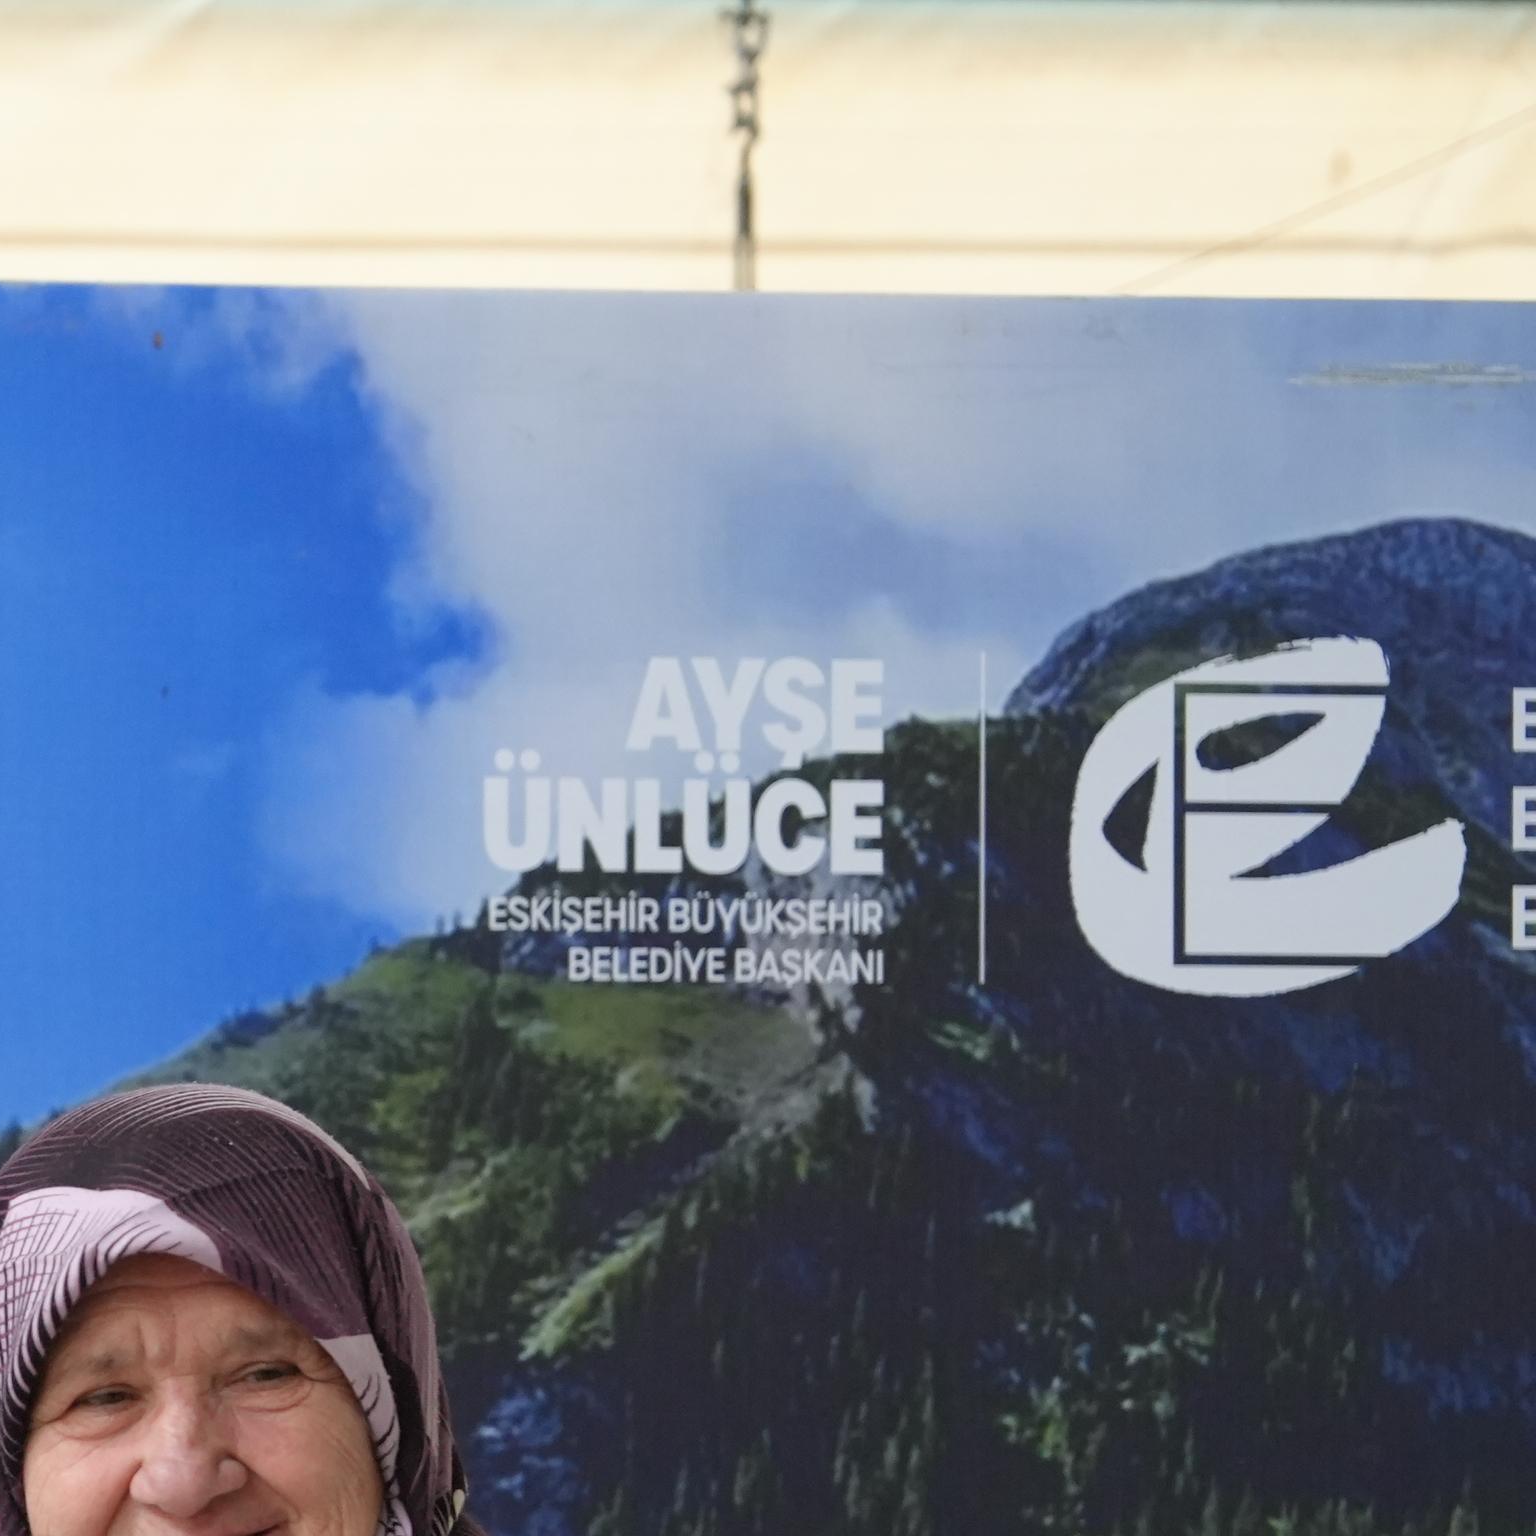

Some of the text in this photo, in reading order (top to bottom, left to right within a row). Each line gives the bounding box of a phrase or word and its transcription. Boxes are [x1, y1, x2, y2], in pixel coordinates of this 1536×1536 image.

[626, 655, 885, 770] AYŞE
[483, 747, 885, 876] ÜNLÜCE
[488, 889, 884, 939] ESKİŞEHİR BÜYÜKŞEHİR
[568, 941, 885, 989] BELEDİYE BAŞKANI
